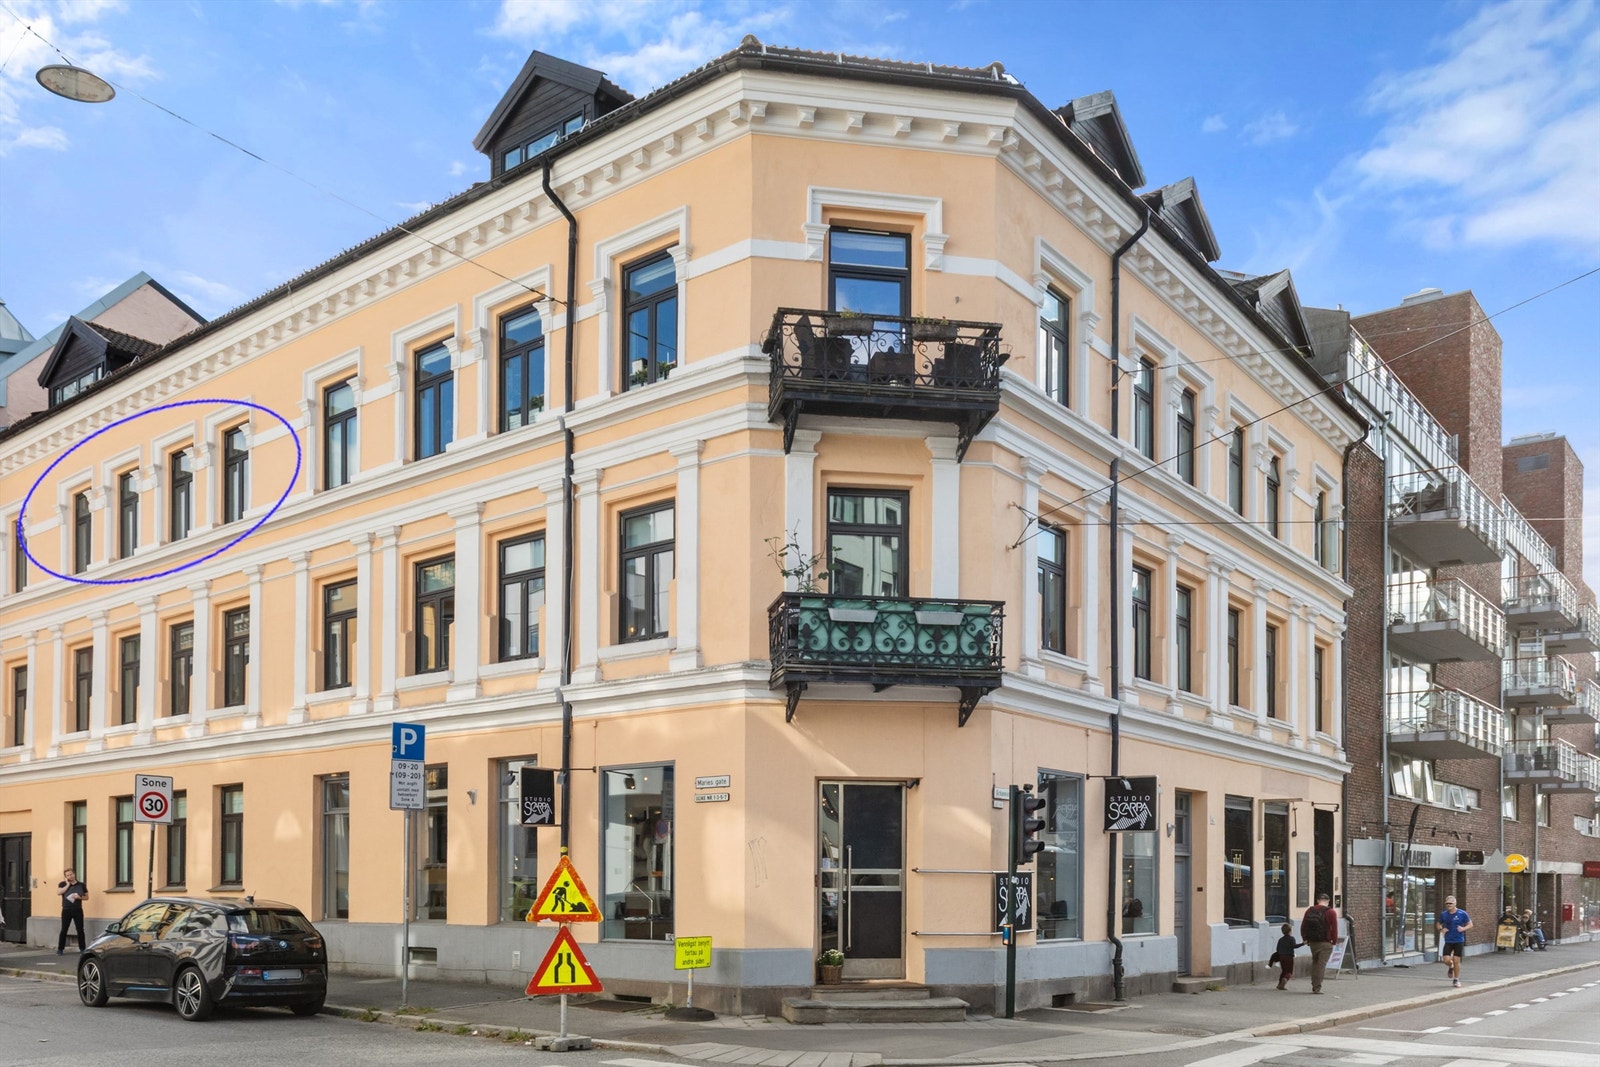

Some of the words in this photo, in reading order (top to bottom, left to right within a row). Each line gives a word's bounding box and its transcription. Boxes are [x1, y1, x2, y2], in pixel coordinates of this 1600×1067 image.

[400, 727, 418, 755] P
[395, 771, 421, 779] (09-20)
[142, 777, 167, 787] Sone
[715, 778, 727, 786] gate
[145, 798, 163, 812] 30
[523, 801, 553, 815] SCARPA
[1108, 802, 1152, 820] SCARPA
[1000, 877, 1029, 885] STDIO
